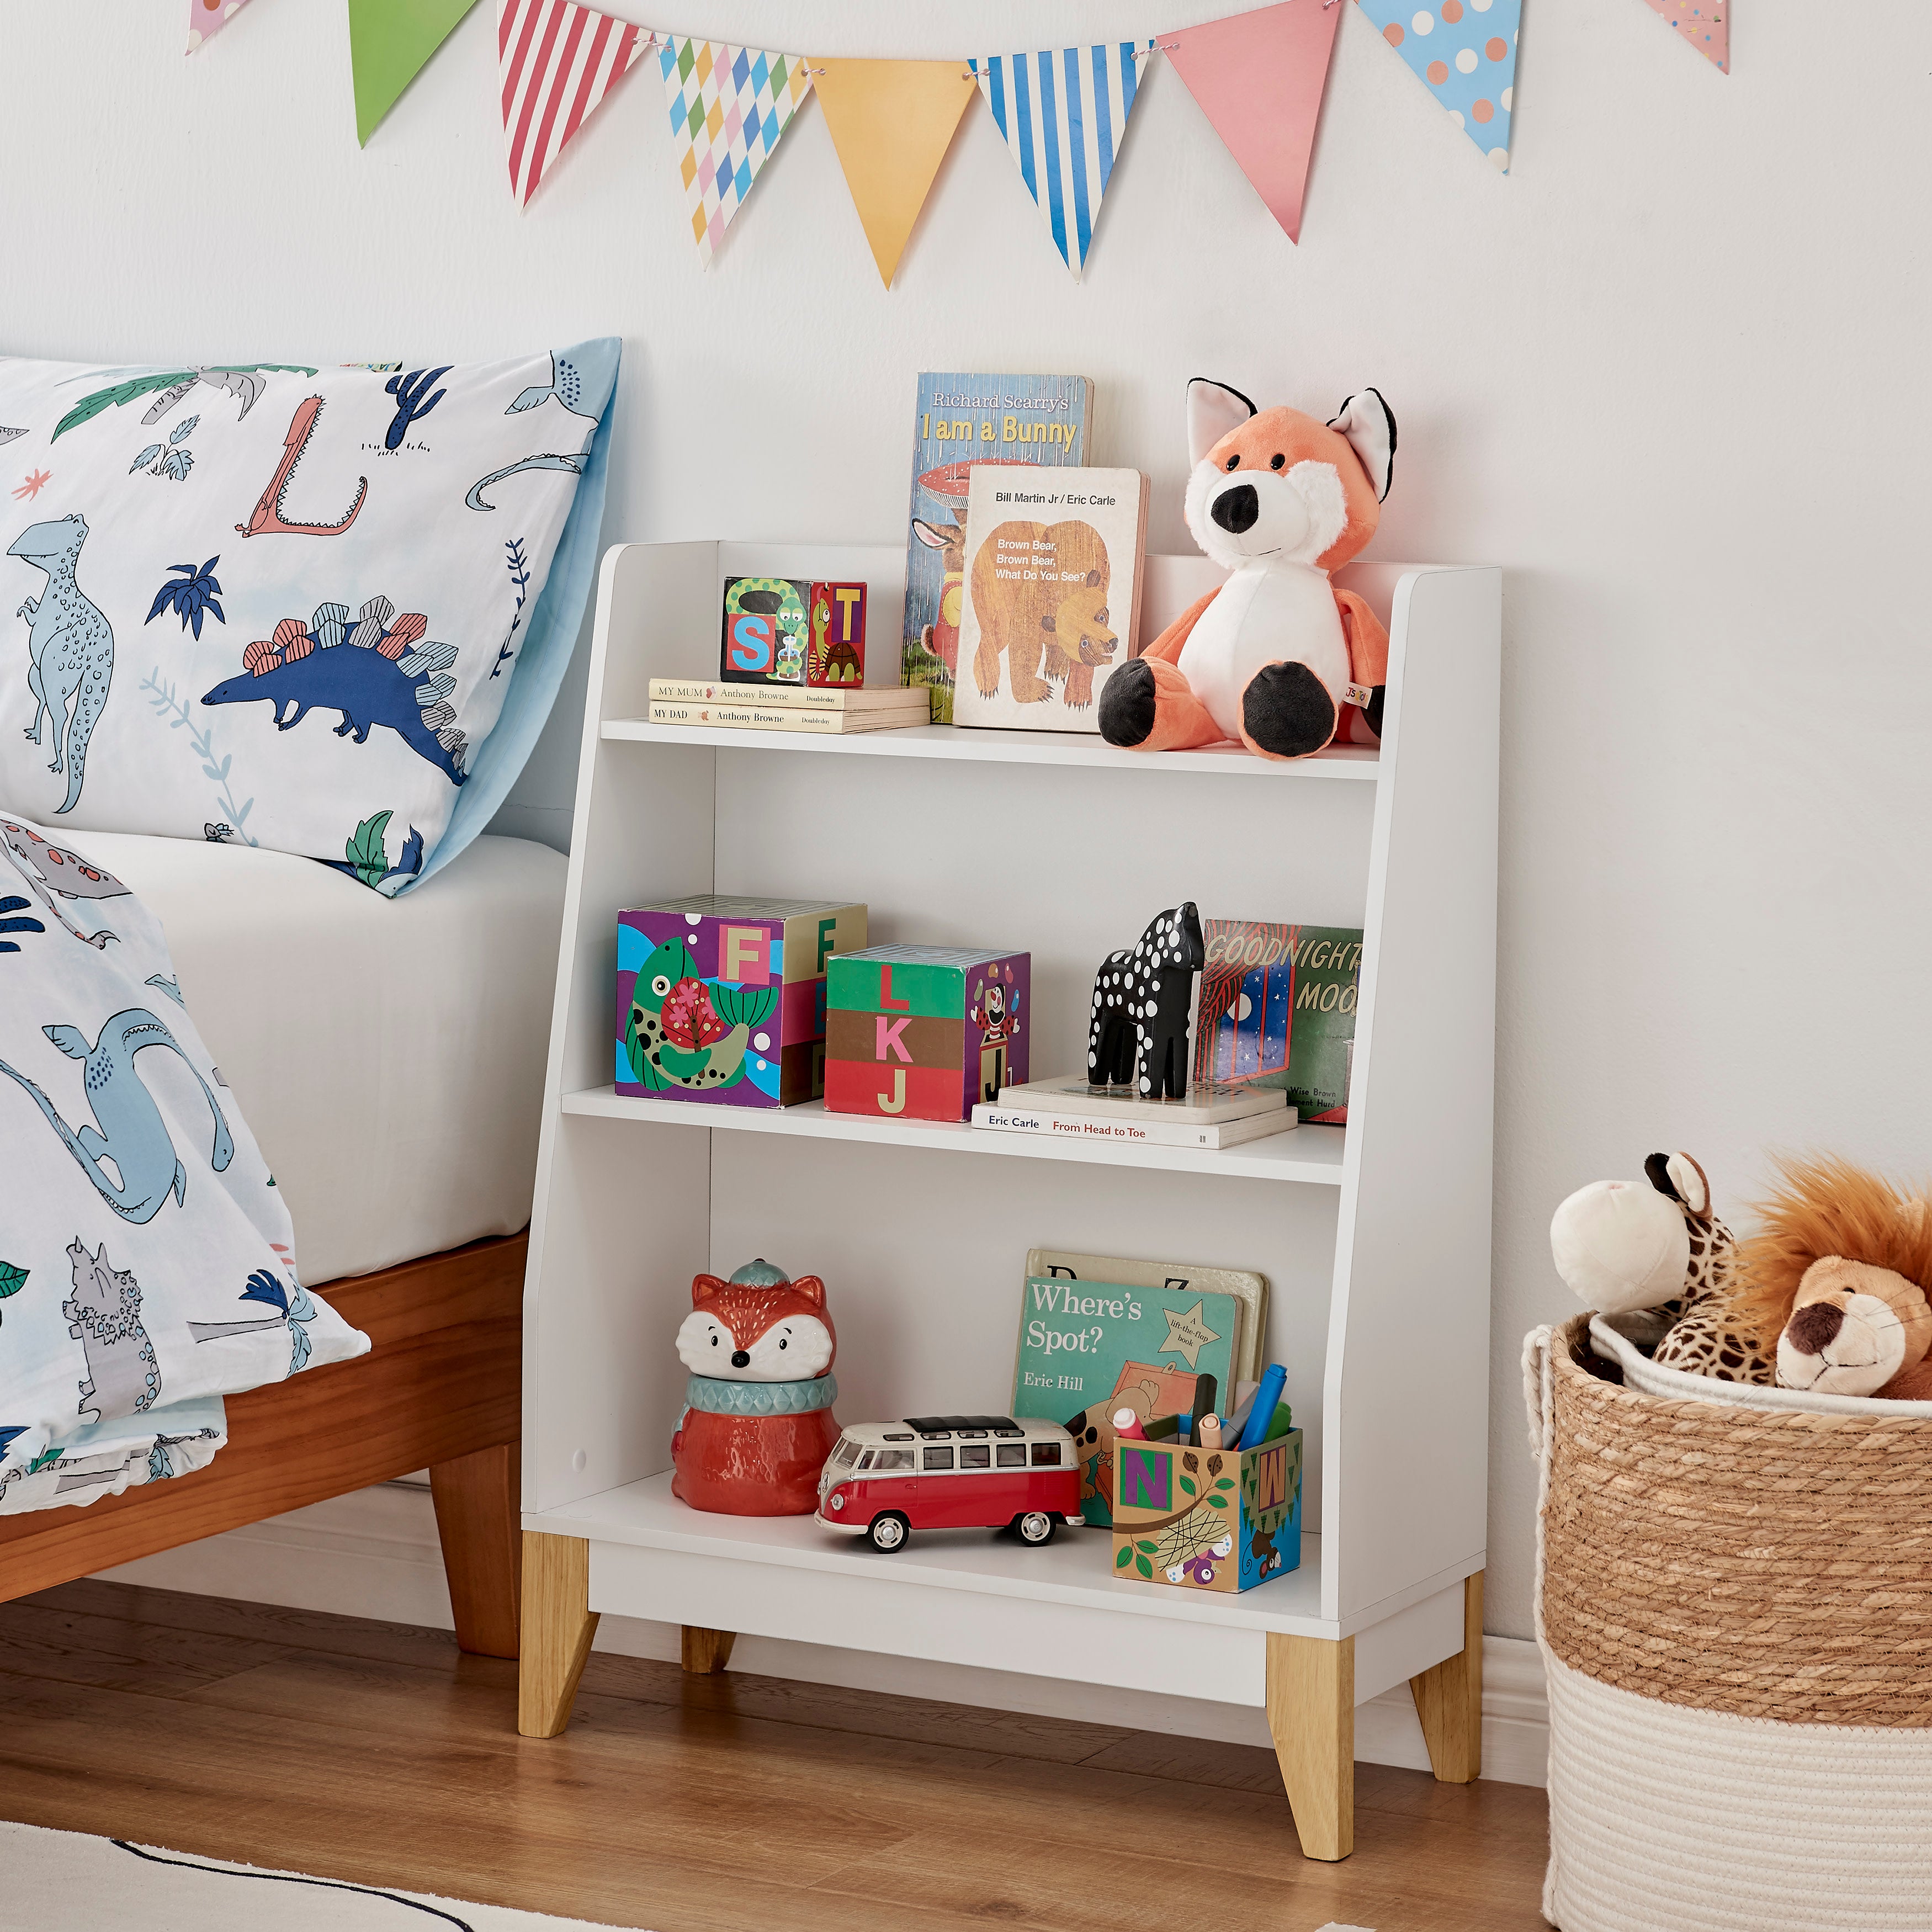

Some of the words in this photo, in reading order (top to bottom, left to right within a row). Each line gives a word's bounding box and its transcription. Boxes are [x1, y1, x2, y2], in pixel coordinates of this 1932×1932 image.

[933, 392, 1000, 408] Richard
[1004, 395, 1069, 412] Scarry's
[923, 413, 930, 439] I
[936, 420, 973, 440] am
[980, 422, 996, 442] a
[1002, 416, 1076, 453] Bunny
[996, 492, 1011, 502] Bill
[1015, 493, 1045, 503] Martin
[1048, 494, 1059, 503] Jr
[1067, 495, 1086, 505] Eric
[1089, 496, 1116, 505] Carle
[996, 554, 1028, 564] Brown
[1031, 555, 1056, 567] Bear,
[997, 539, 1029, 549] Brown
[1032, 540, 1057, 552] Bear,
[996, 569, 1023, 579] What
[1023, 570, 1037, 580] Do
[1039, 570, 1058, 580] You
[1061, 571, 1086, 581] See?
[836, 588, 860, 641] T
[731, 616, 769, 671] S
[659, 687, 675, 696] MY
[677, 688, 702, 697] MUM
[720, 689, 756, 699] Anthony
[758, 691, 788, 700] Browne
[654, 709, 666, 718] MY
[670, 709, 687, 719] DAD
[716, 712, 751, 722] Anthony
[754, 713, 784, 723] Browne
[802, 716, 830, 725] Doubleday
[726, 927, 762, 980] F
[817, 918, 836, 973] F
[1205, 934, 1363, 972] GOODNIGHT
[880, 964, 910, 1011] L
[1296, 981, 1357, 1014] MOO
[876, 1016, 914, 1063] K
[877, 1069, 906, 1113] J
[985, 1048, 1002, 1102] J
[1291, 1086, 1309, 1095] Wise
[1314, 1088, 1336, 1097] Brown
[1287, 1096, 1313, 1106] lement
[1317, 1099, 1335, 1107] Hurd
[989, 1115, 1009, 1126] Eric
[1012, 1117, 1039, 1128] Carle
[1053, 1121, 1080, 1132] From
[1084, 1123, 1111, 1135] Head
[1114, 1127, 1125, 1137] to
[1127, 1127, 1145, 1138] Toe
[1031, 1283, 1142, 1320] Where's
[1026, 1320, 1103, 1355] Spot?
[1170, 1319, 1208, 1342] lift-the-flap
[1177, 1334, 1193, 1347] book
[1023, 1372, 1053, 1388] Eric
[1057, 1375, 1083, 1391] Hill
[1126, 1450, 1167, 1509] N
